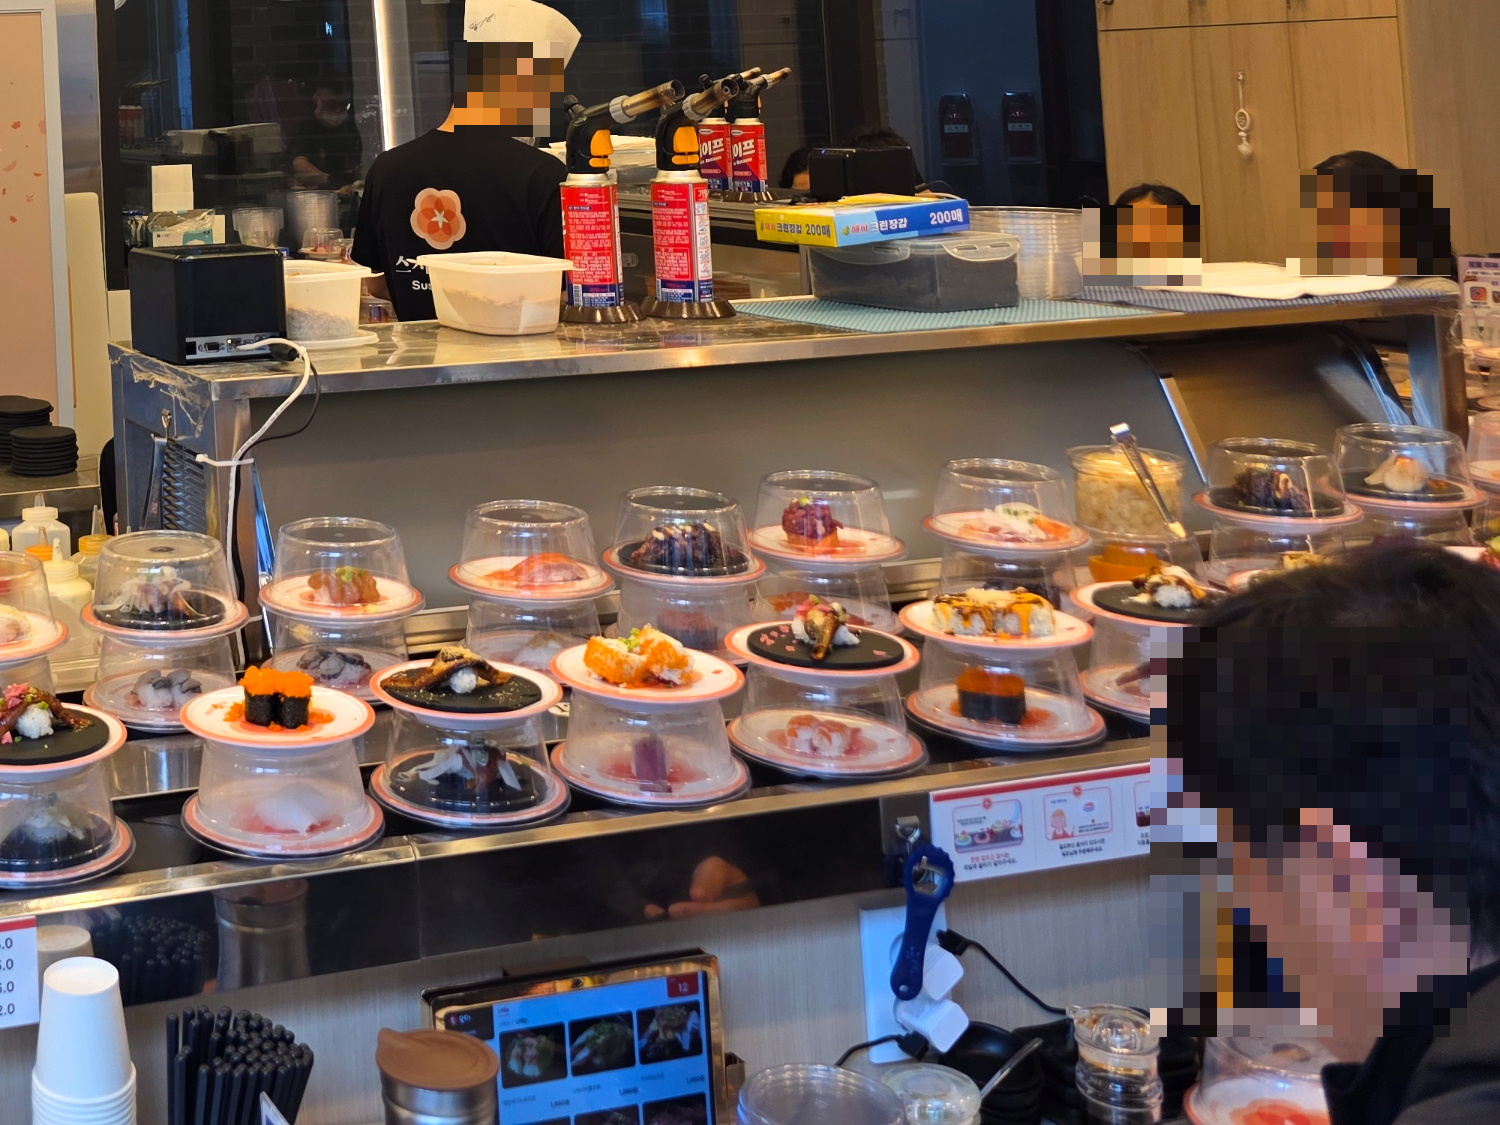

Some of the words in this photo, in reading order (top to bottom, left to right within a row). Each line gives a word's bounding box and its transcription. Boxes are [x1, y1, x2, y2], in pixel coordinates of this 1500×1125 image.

[869, 216, 908, 233] 크린장갑
[929, 207, 964, 226] 200매
[776, 222, 803, 235] 크린장갑
[805, 223, 831, 238] 200매
[677, 981, 689, 994] 12
